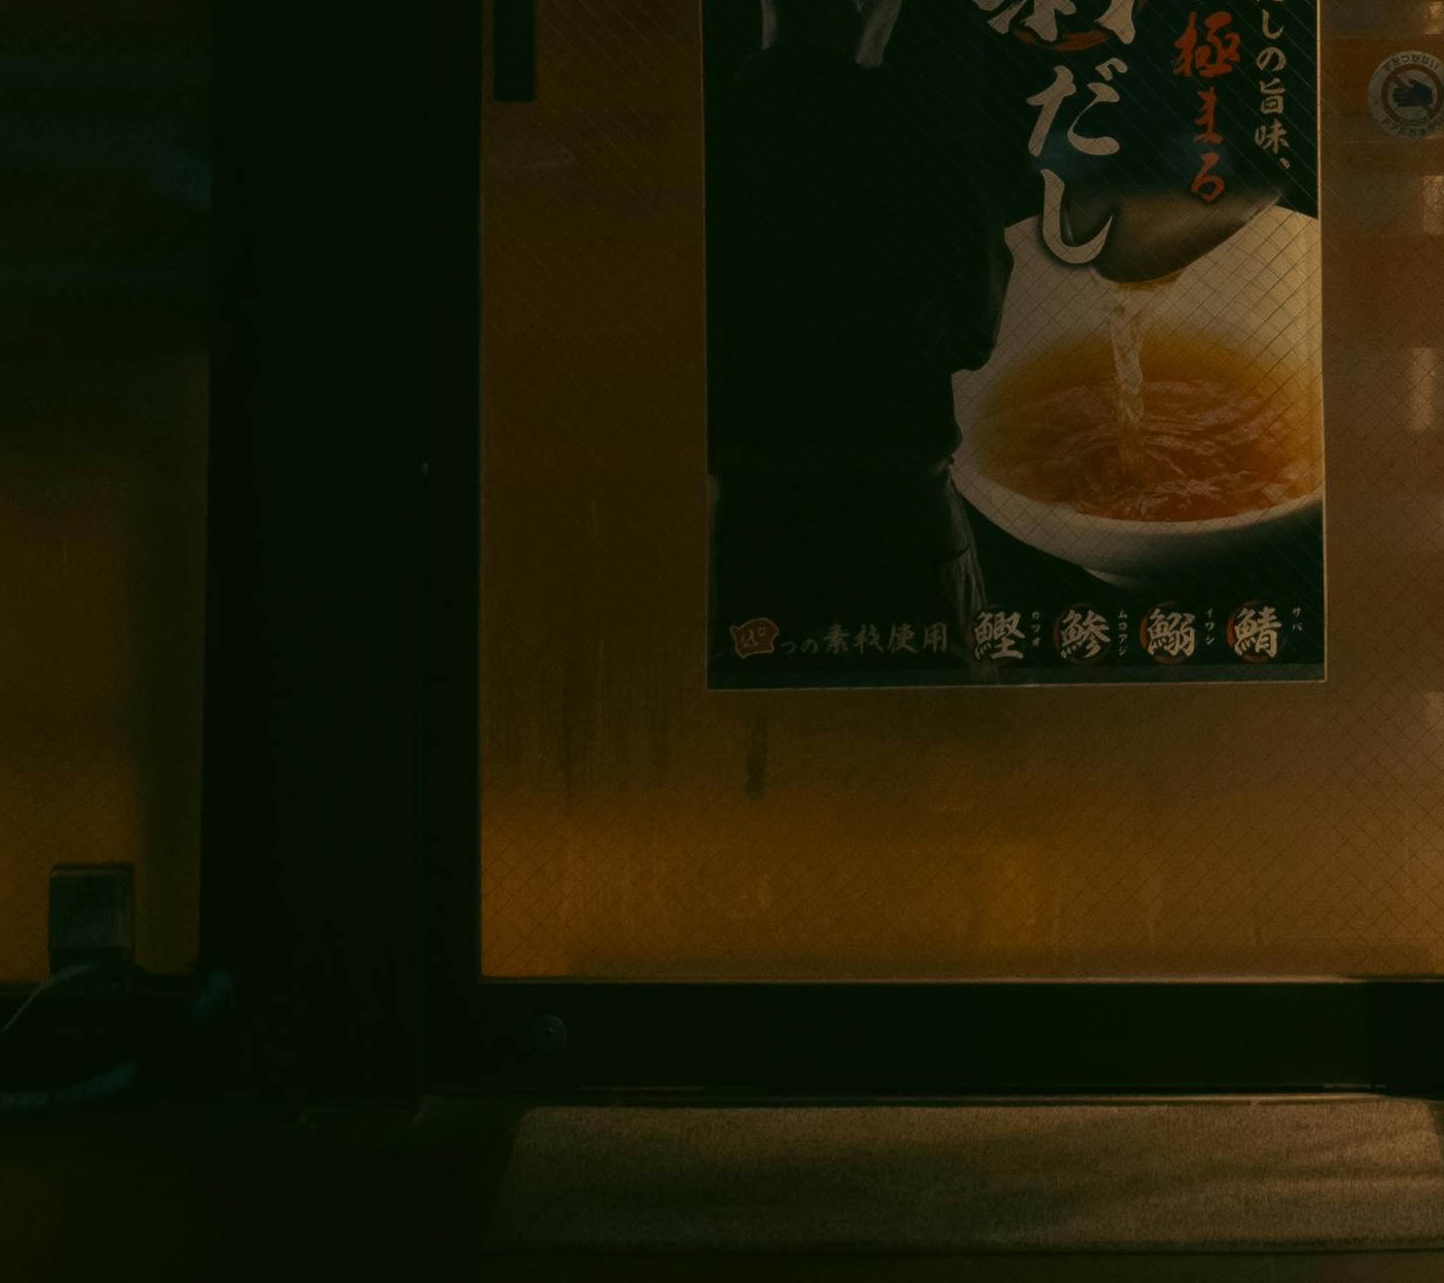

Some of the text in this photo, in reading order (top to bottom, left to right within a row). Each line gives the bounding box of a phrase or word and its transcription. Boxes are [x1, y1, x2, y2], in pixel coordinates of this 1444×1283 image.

[972, 609, 1026, 662] 鰹
[1145, 609, 1198, 662] 鰯
[1232, 607, 1281, 660] 鯖
